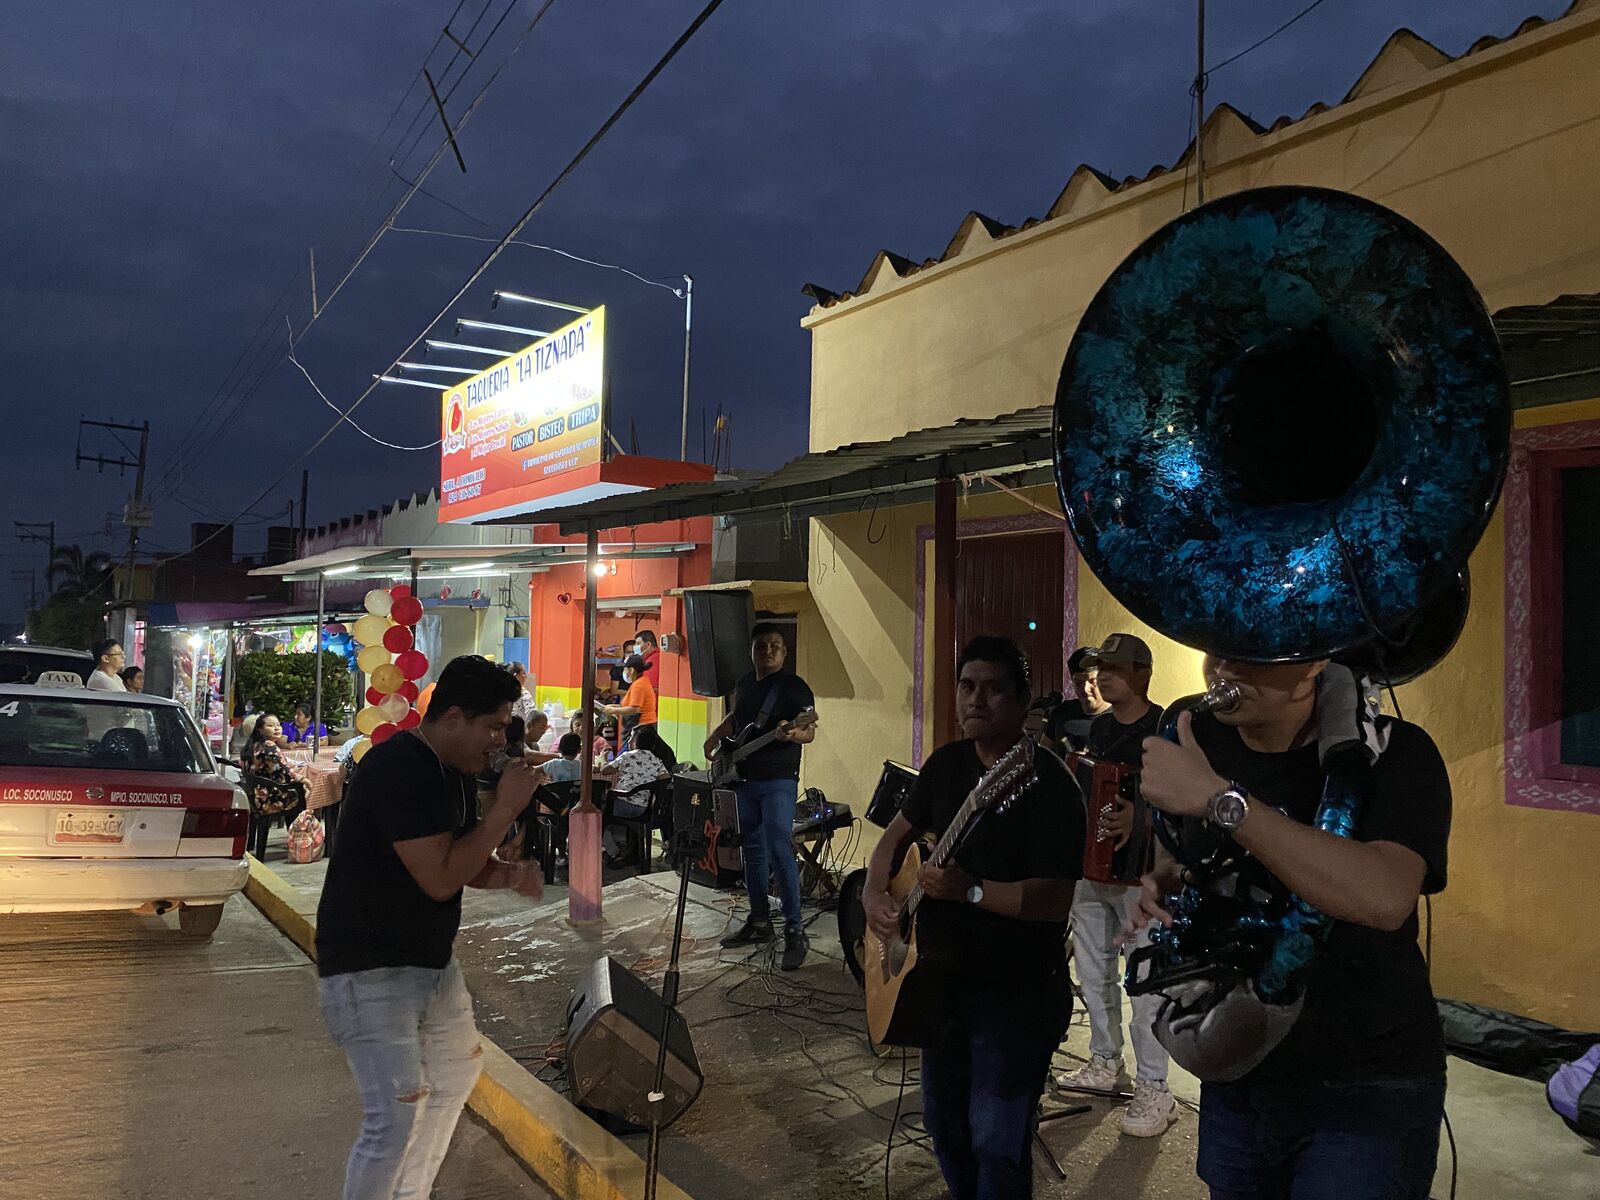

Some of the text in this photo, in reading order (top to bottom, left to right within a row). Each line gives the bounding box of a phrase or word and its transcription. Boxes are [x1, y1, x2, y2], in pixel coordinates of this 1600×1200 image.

[467, 366, 509, 408] TAQUERIA
[570, 405, 597, 429] TRIPA
[540, 418, 564, 441] BISTEC
[512, 430, 534, 451] PASTOR
[47, 673, 75, 683] TAXI
[3, 789, 73, 802] LOC. SOCONUSCO
[110, 791, 127, 803] MPIO.
[170, 793, 183, 804] VER.
